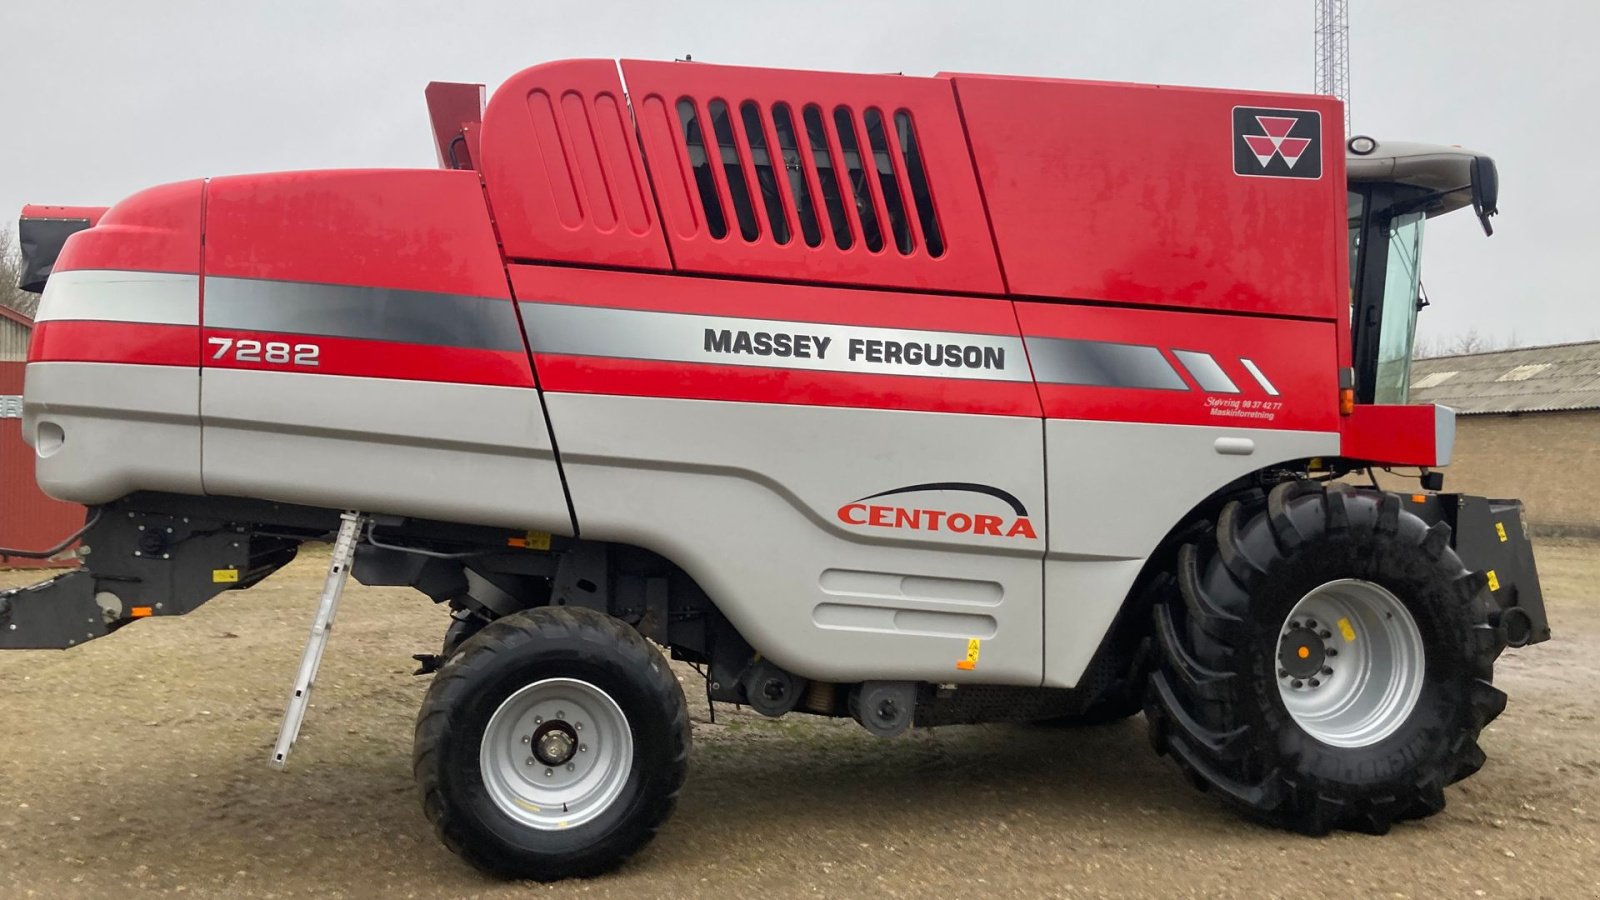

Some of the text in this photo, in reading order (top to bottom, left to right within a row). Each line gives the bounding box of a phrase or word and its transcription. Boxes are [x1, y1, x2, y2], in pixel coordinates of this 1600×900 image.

[208, 337, 320, 366] 7282
[704, 328, 1005, 370] MASSEY FERGUSON
[1204, 396, 1240, 410] Støvring
[1210, 407, 1275, 421] Maskinforretning
[837, 503, 1038, 539] CENTORA
